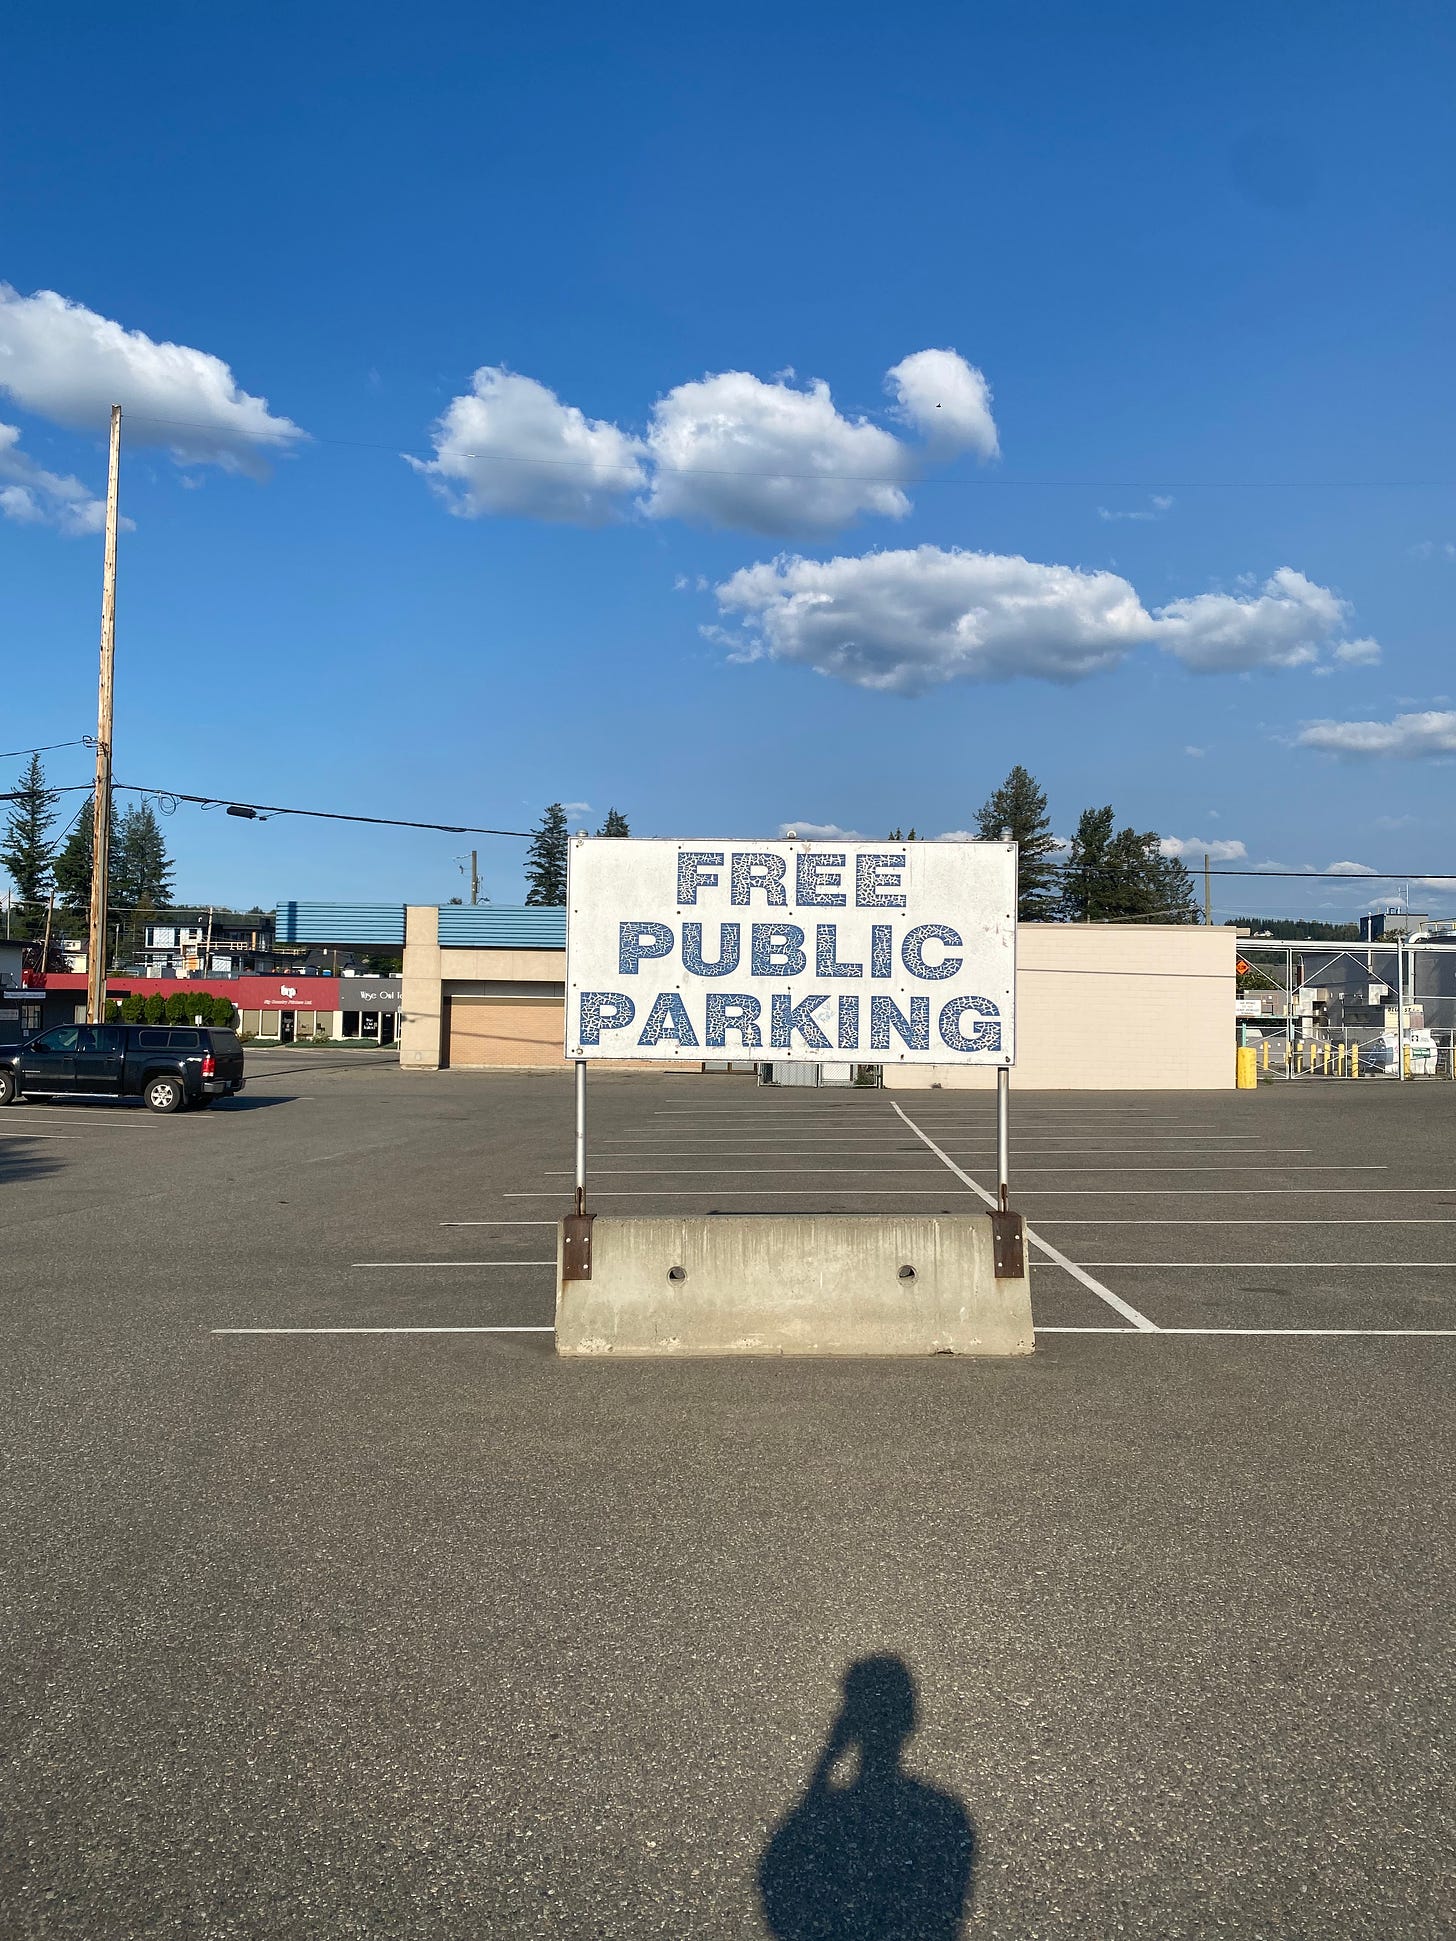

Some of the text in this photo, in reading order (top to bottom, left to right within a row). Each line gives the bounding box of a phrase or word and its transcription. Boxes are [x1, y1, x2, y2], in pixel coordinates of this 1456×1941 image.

[677, 852, 907, 907] FREE
[619, 922, 964, 980] PUBLIC
[579, 992, 1002, 1052] PARKING
